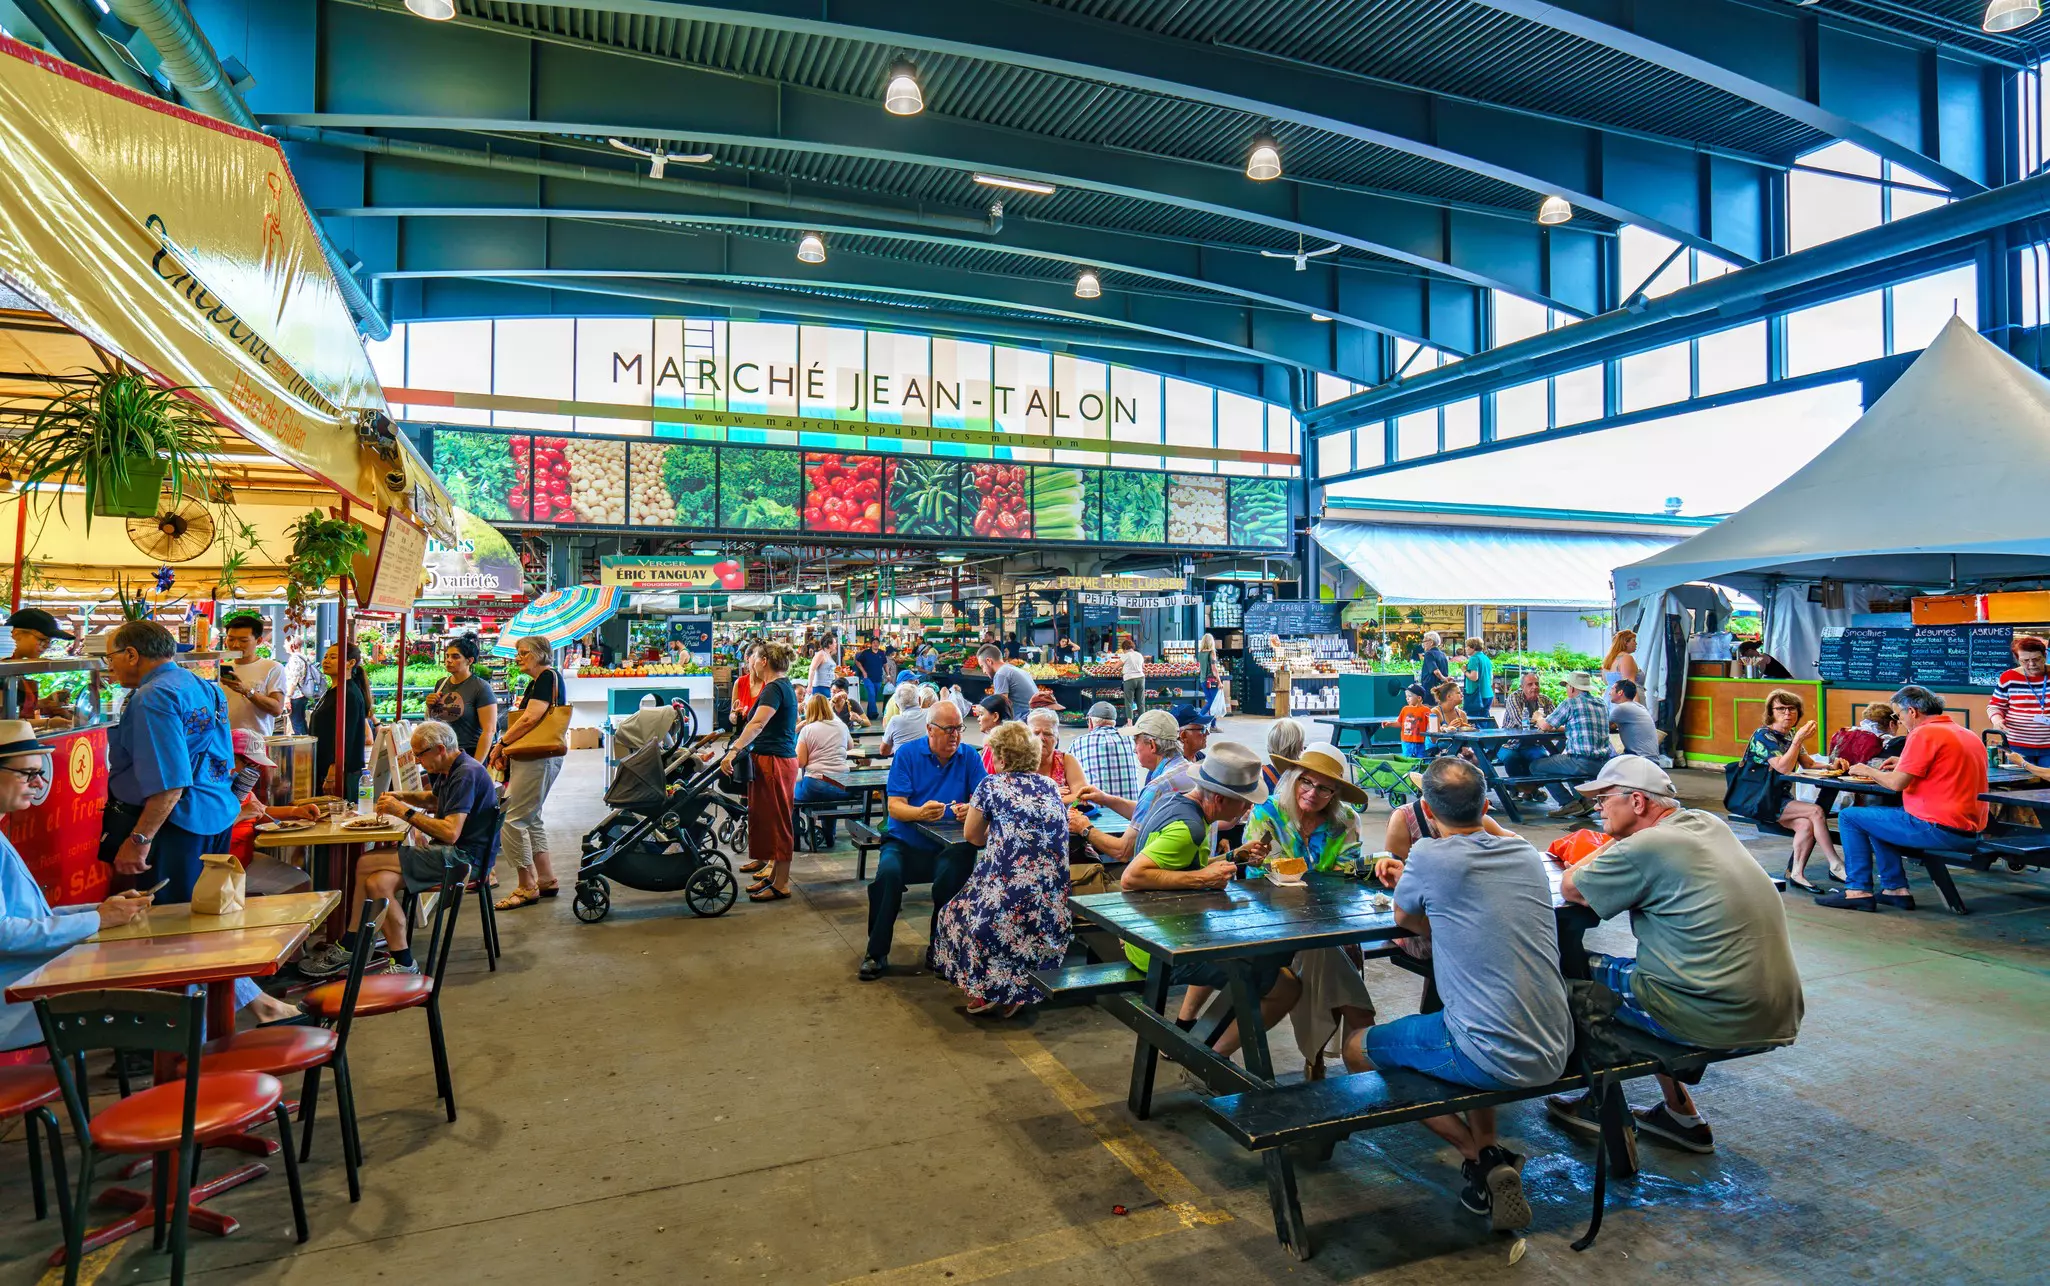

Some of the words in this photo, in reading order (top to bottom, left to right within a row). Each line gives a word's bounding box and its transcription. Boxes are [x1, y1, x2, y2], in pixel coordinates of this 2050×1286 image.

[612, 351, 825, 399] MARCHÉ
[849, 373, 1137, 425] JEAN-TALON
[276, 406, 307, 452] Gluten
[693, 412, 1080, 448] www.marchespublics-mtl.com
[637, 559, 688, 567] VERGER
[443, 573, 499, 588] variétés
[616, 567, 646, 580] ÉRIC
[649, 569, 707, 580] TANGUAY
[1059, 576, 1099, 589] FERME
[1084, 593, 1119, 607] PETITS
[1125, 596, 1159, 608] FRUITS
[1164, 596, 1177, 606] DU
[1183, 595, 1197, 605] QC
[1250, 603, 1269, 612] SIROP
[1311, 604, 1325, 612] PUR
[1844, 628, 1887, 638] Smoothies
[72, 795, 106, 824] From
